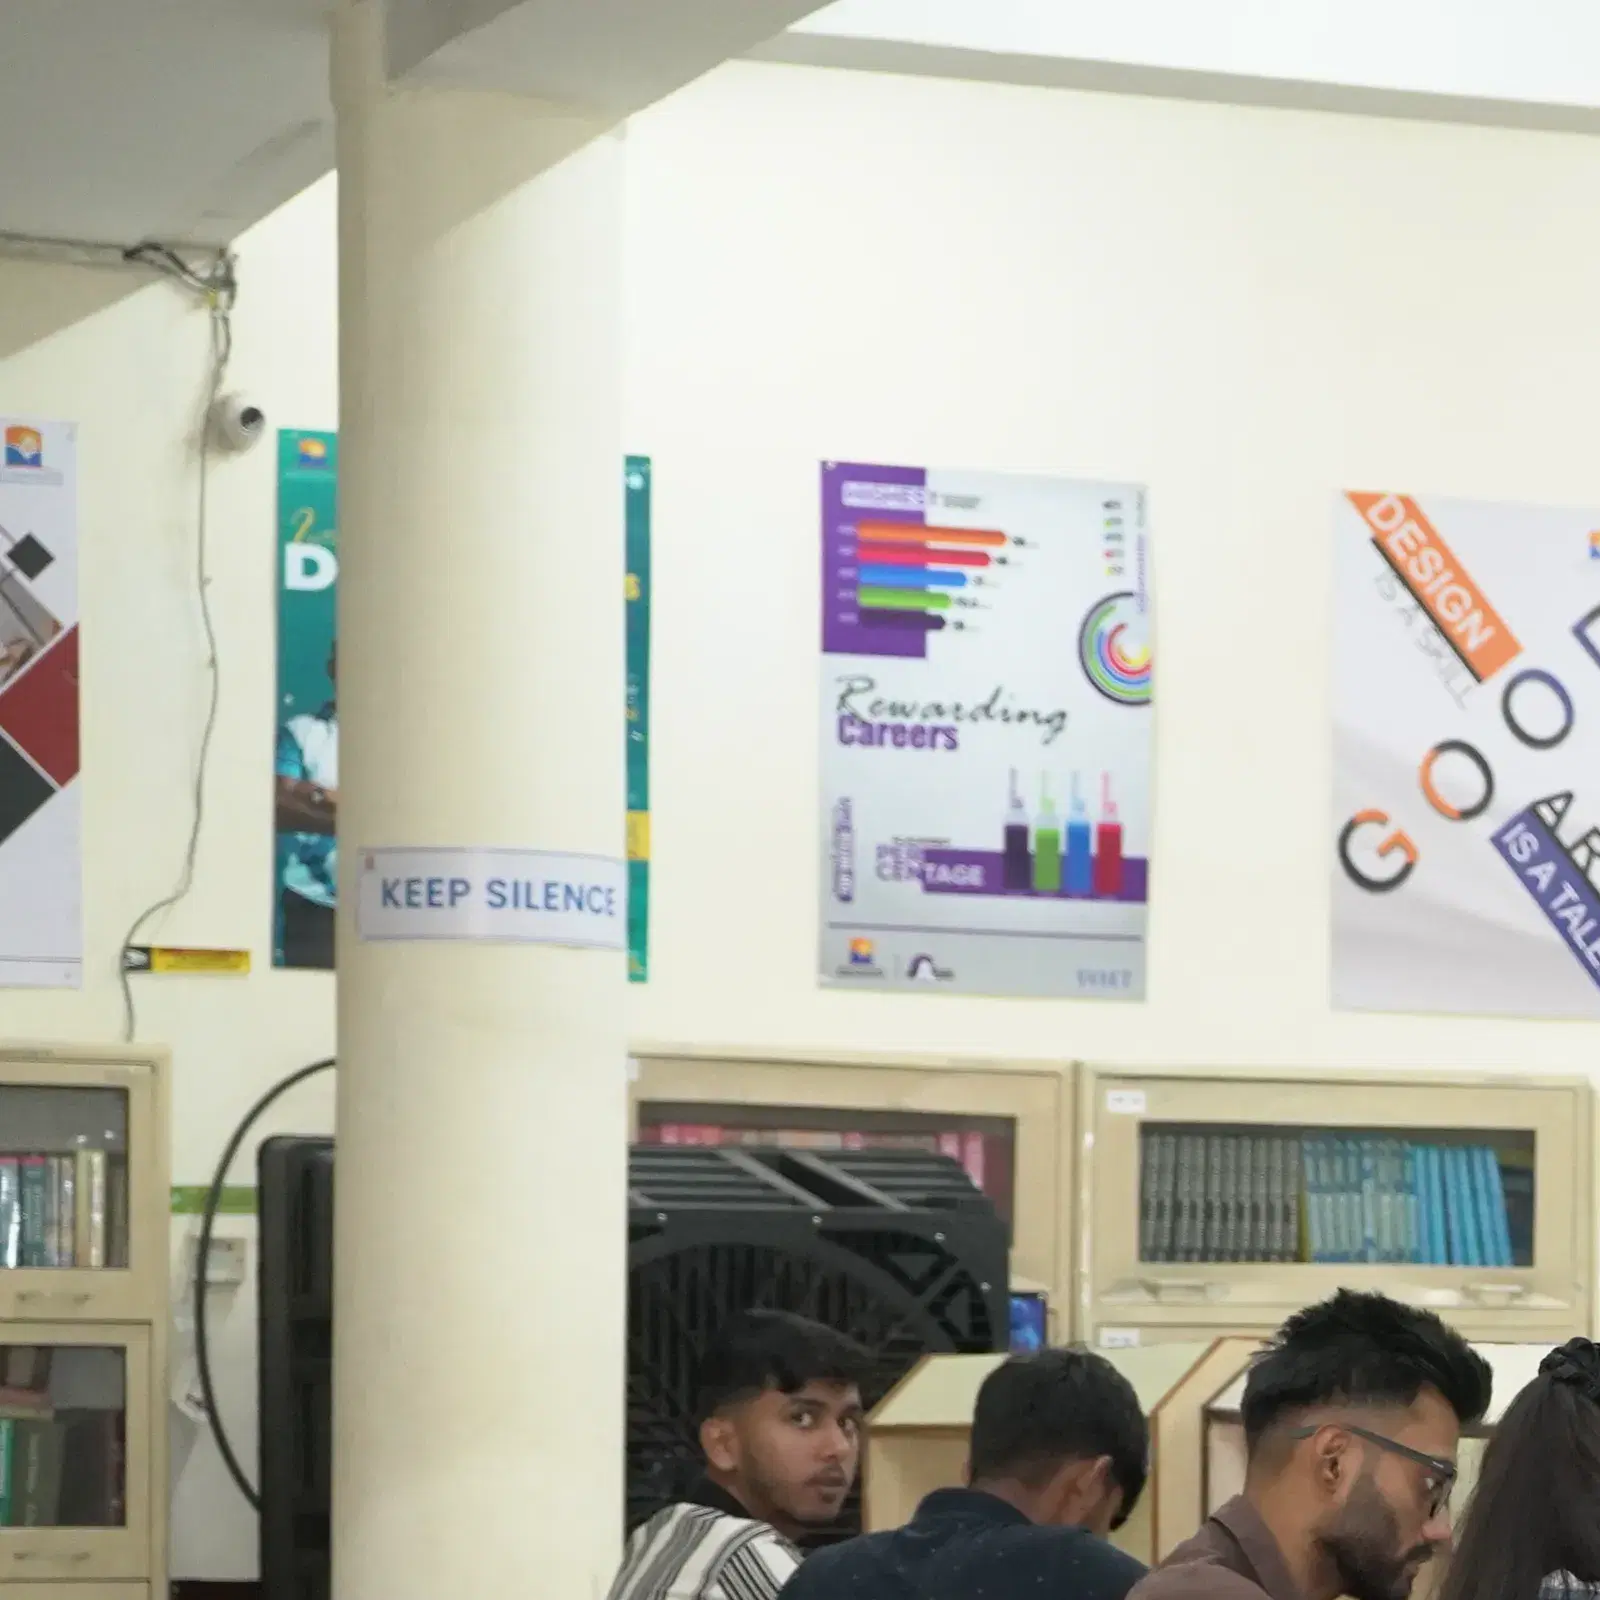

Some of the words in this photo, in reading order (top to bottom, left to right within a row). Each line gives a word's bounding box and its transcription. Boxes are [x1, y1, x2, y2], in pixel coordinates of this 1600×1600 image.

[1367, 494, 1496, 653] DESIGN
[835, 675, 1067, 746] Rewarding
[838, 713, 959, 750] Careers
[1500, 821, 1540, 863] IS
[1525, 860, 1558, 893] A
[381, 876, 472, 909] KEEP
[485, 879, 616, 917] SILENCE
